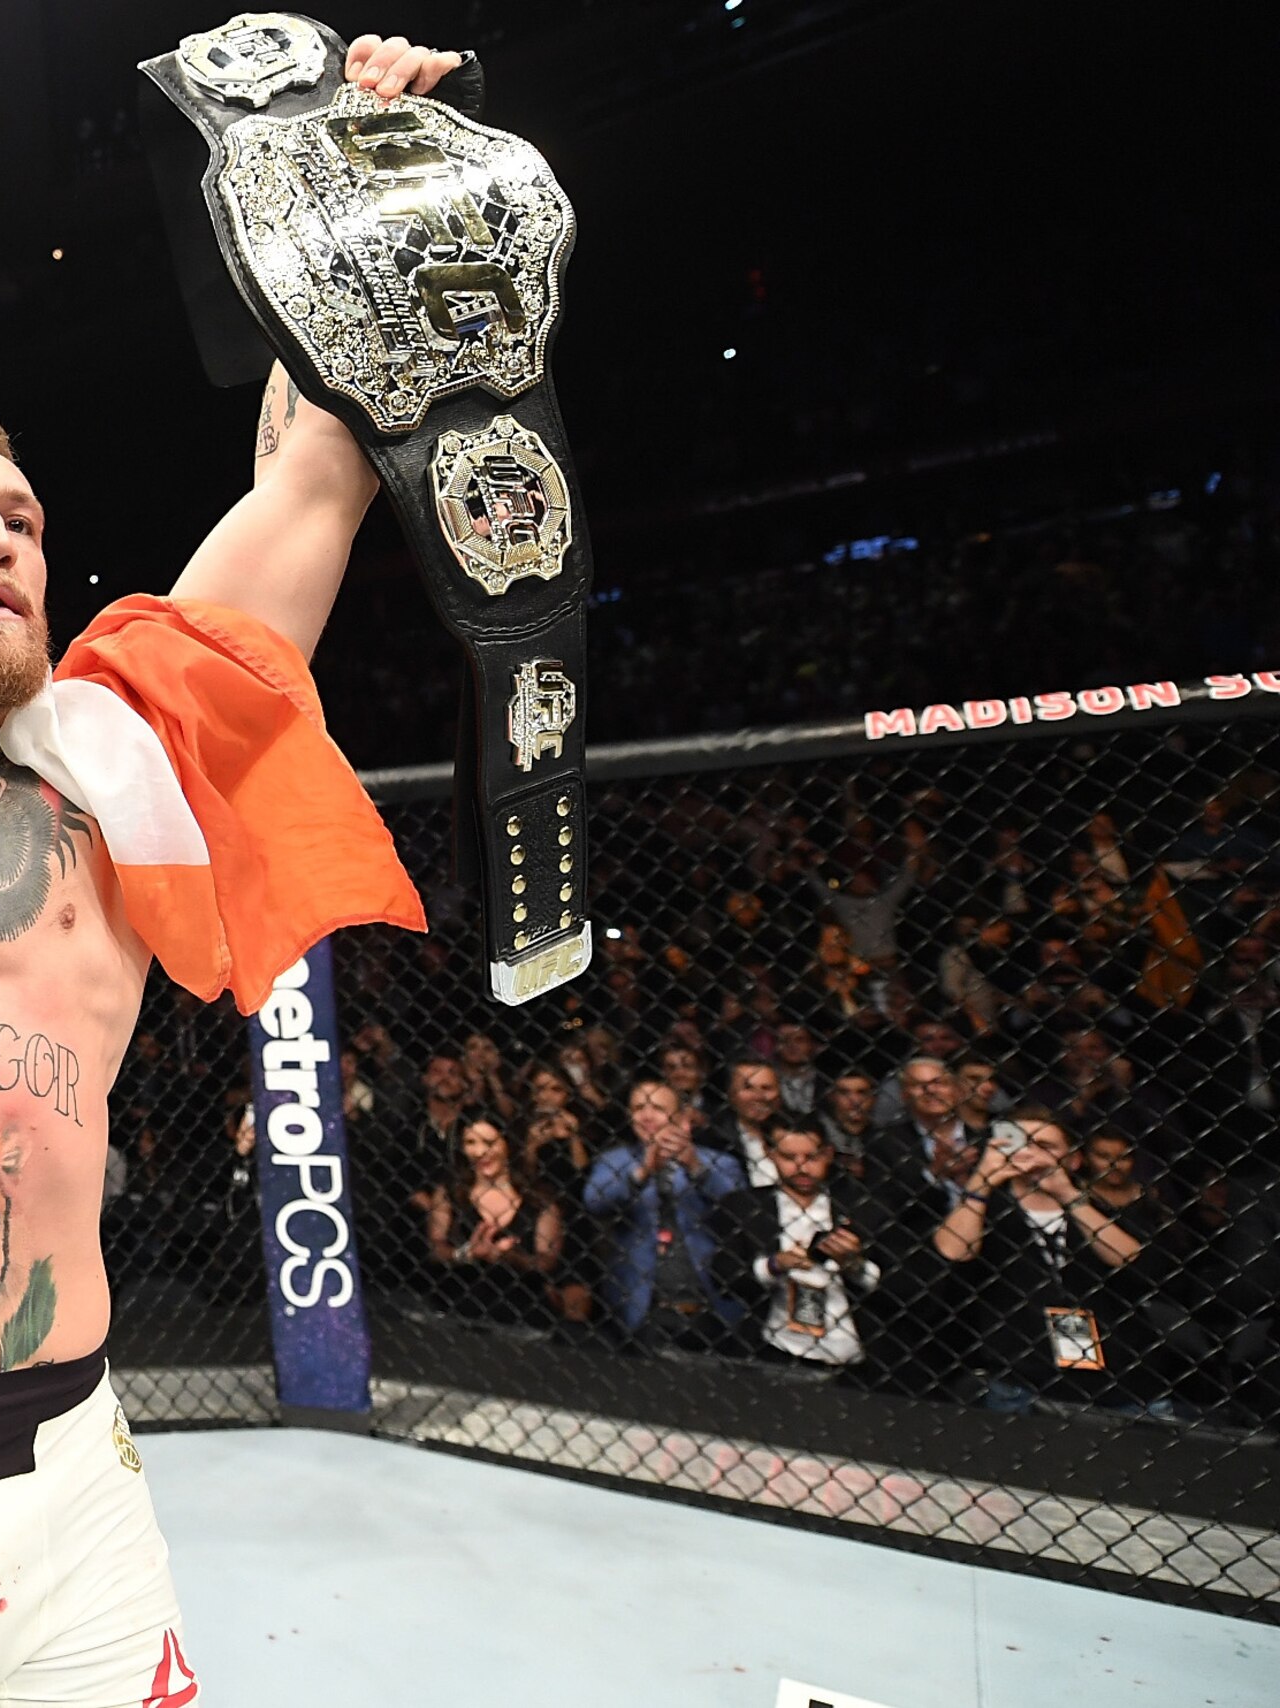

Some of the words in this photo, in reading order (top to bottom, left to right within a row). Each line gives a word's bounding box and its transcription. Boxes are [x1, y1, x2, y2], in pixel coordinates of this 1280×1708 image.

[327, 111, 526, 346] UFC
[531, 660, 564, 761] UFC
[864, 680, 1182, 740] MADISON
[515, 939, 584, 998] UFC
